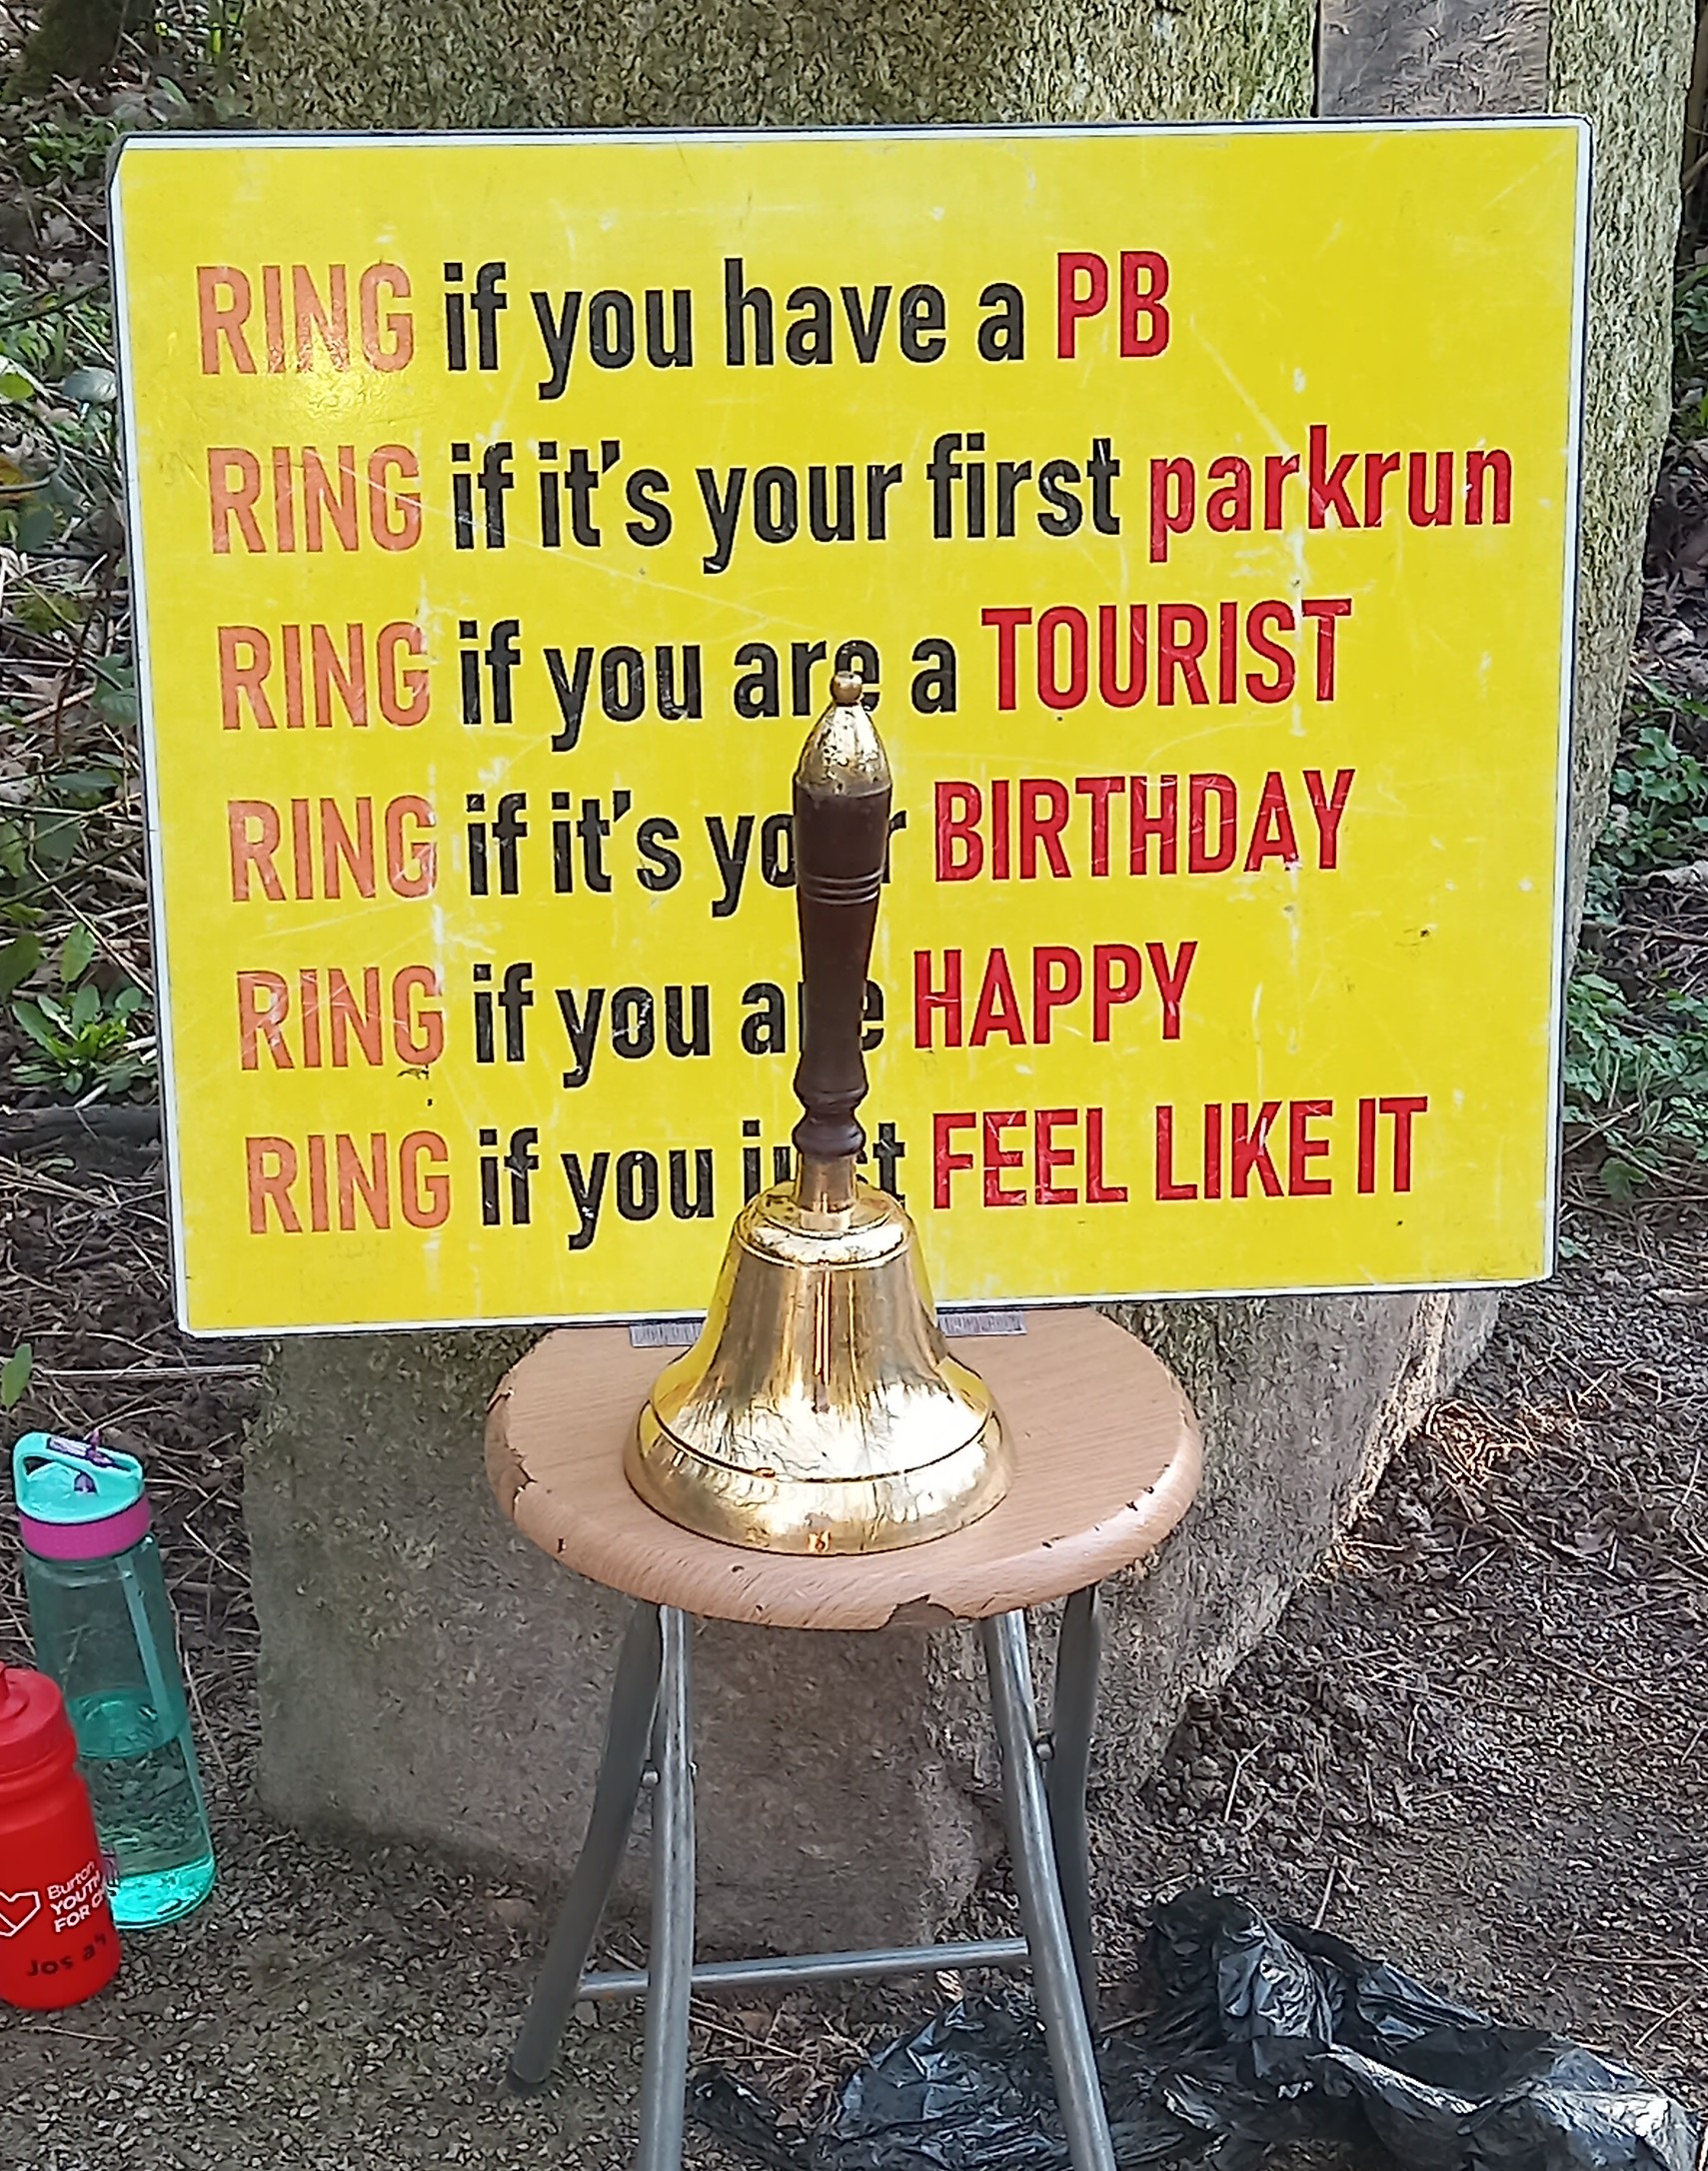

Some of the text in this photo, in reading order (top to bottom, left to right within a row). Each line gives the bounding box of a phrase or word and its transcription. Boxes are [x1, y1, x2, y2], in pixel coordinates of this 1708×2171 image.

[196, 250, 1170, 401] RING if you have a PB
[207, 424, 1512, 575] RING if it's your first parkrun
[217, 598, 1353, 753] RING if you are a TOURIST
[228, 768, 1356, 920] RING if it's yo BIRTHDAY
[236, 941, 1198, 1089] RING if you ae HAPPY
[245, 1094, 1429, 1251] RING if you jt FEEL LIKE IT
[46, 1860, 96, 1900] Burton
[50, 1869, 101, 1916] YOUTH
[53, 1904, 91, 1933] FOR
